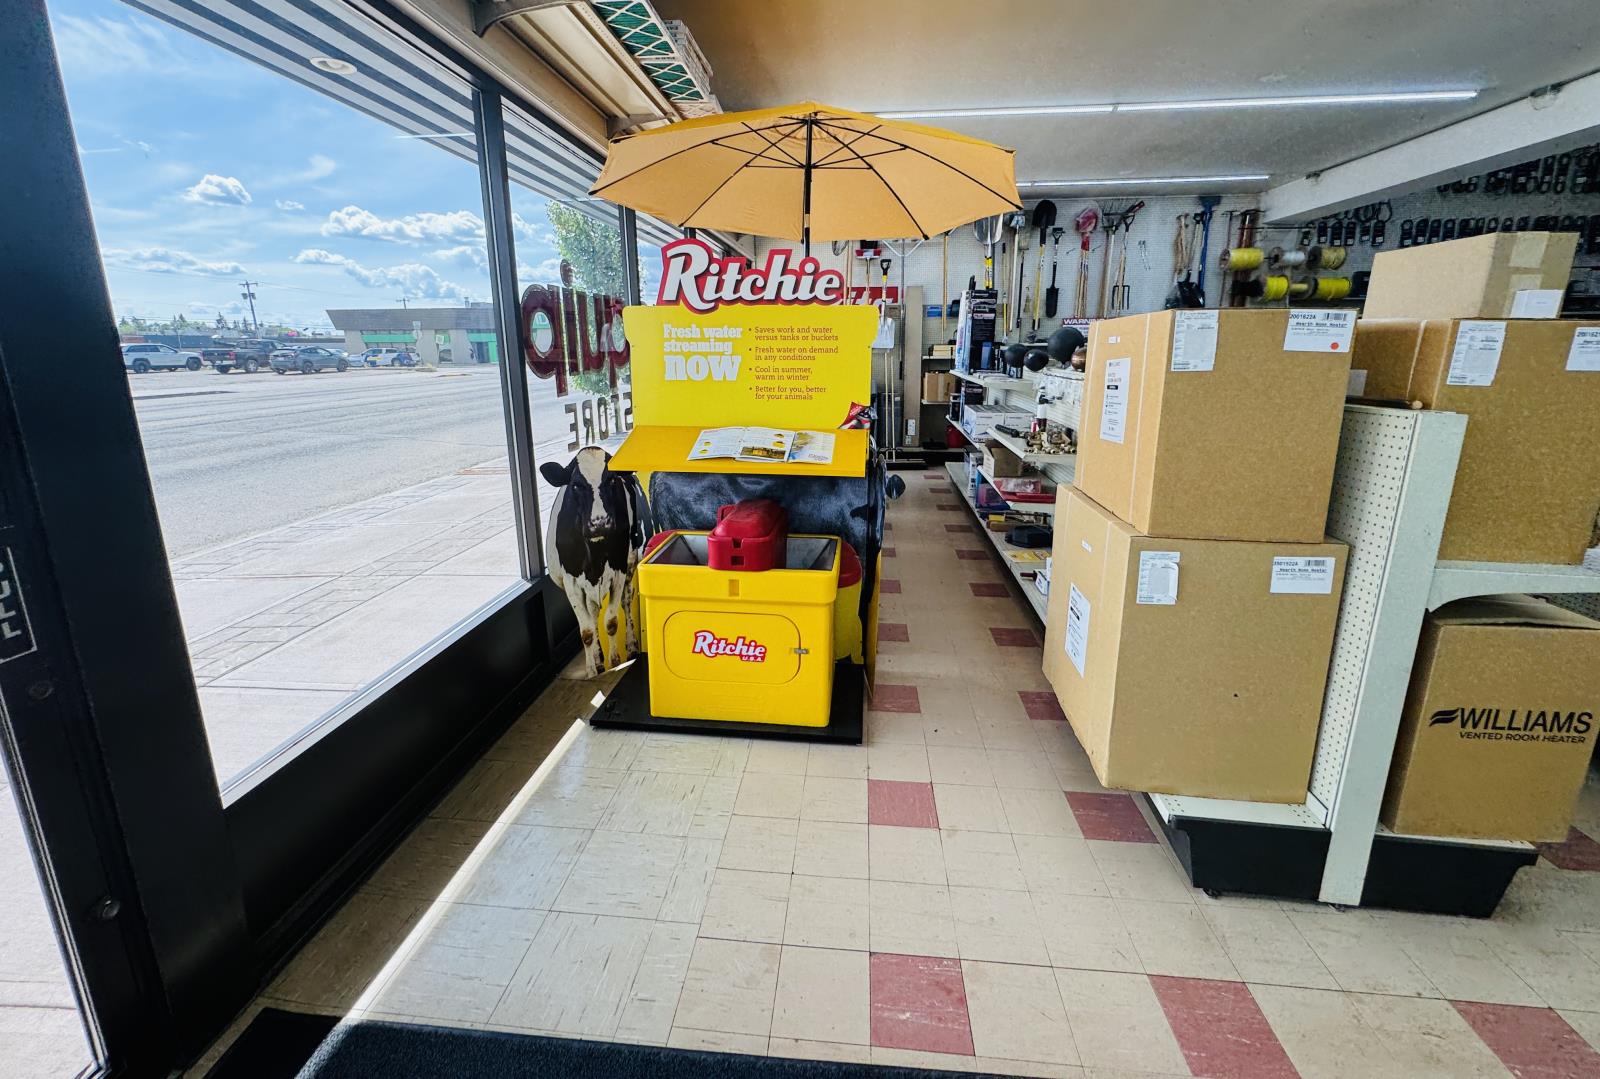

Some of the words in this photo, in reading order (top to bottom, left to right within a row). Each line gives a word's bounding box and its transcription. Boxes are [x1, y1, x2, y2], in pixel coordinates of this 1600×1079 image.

[660, 242, 842, 311] Ritchie
[663, 323, 701, 338] Fresh
[703, 325, 742, 338] water
[663, 339, 733, 354] streaming
[663, 355, 742, 382] now
[766, 394, 782, 402] your
[692, 631, 767, 657] Ritchie
[1458, 707, 1593, 735] WILLIAMS
[1459, 732, 1503, 740] VENTED
[1505, 733, 1540, 742] ROOM
[1542, 734, 1586, 744] HEATER
